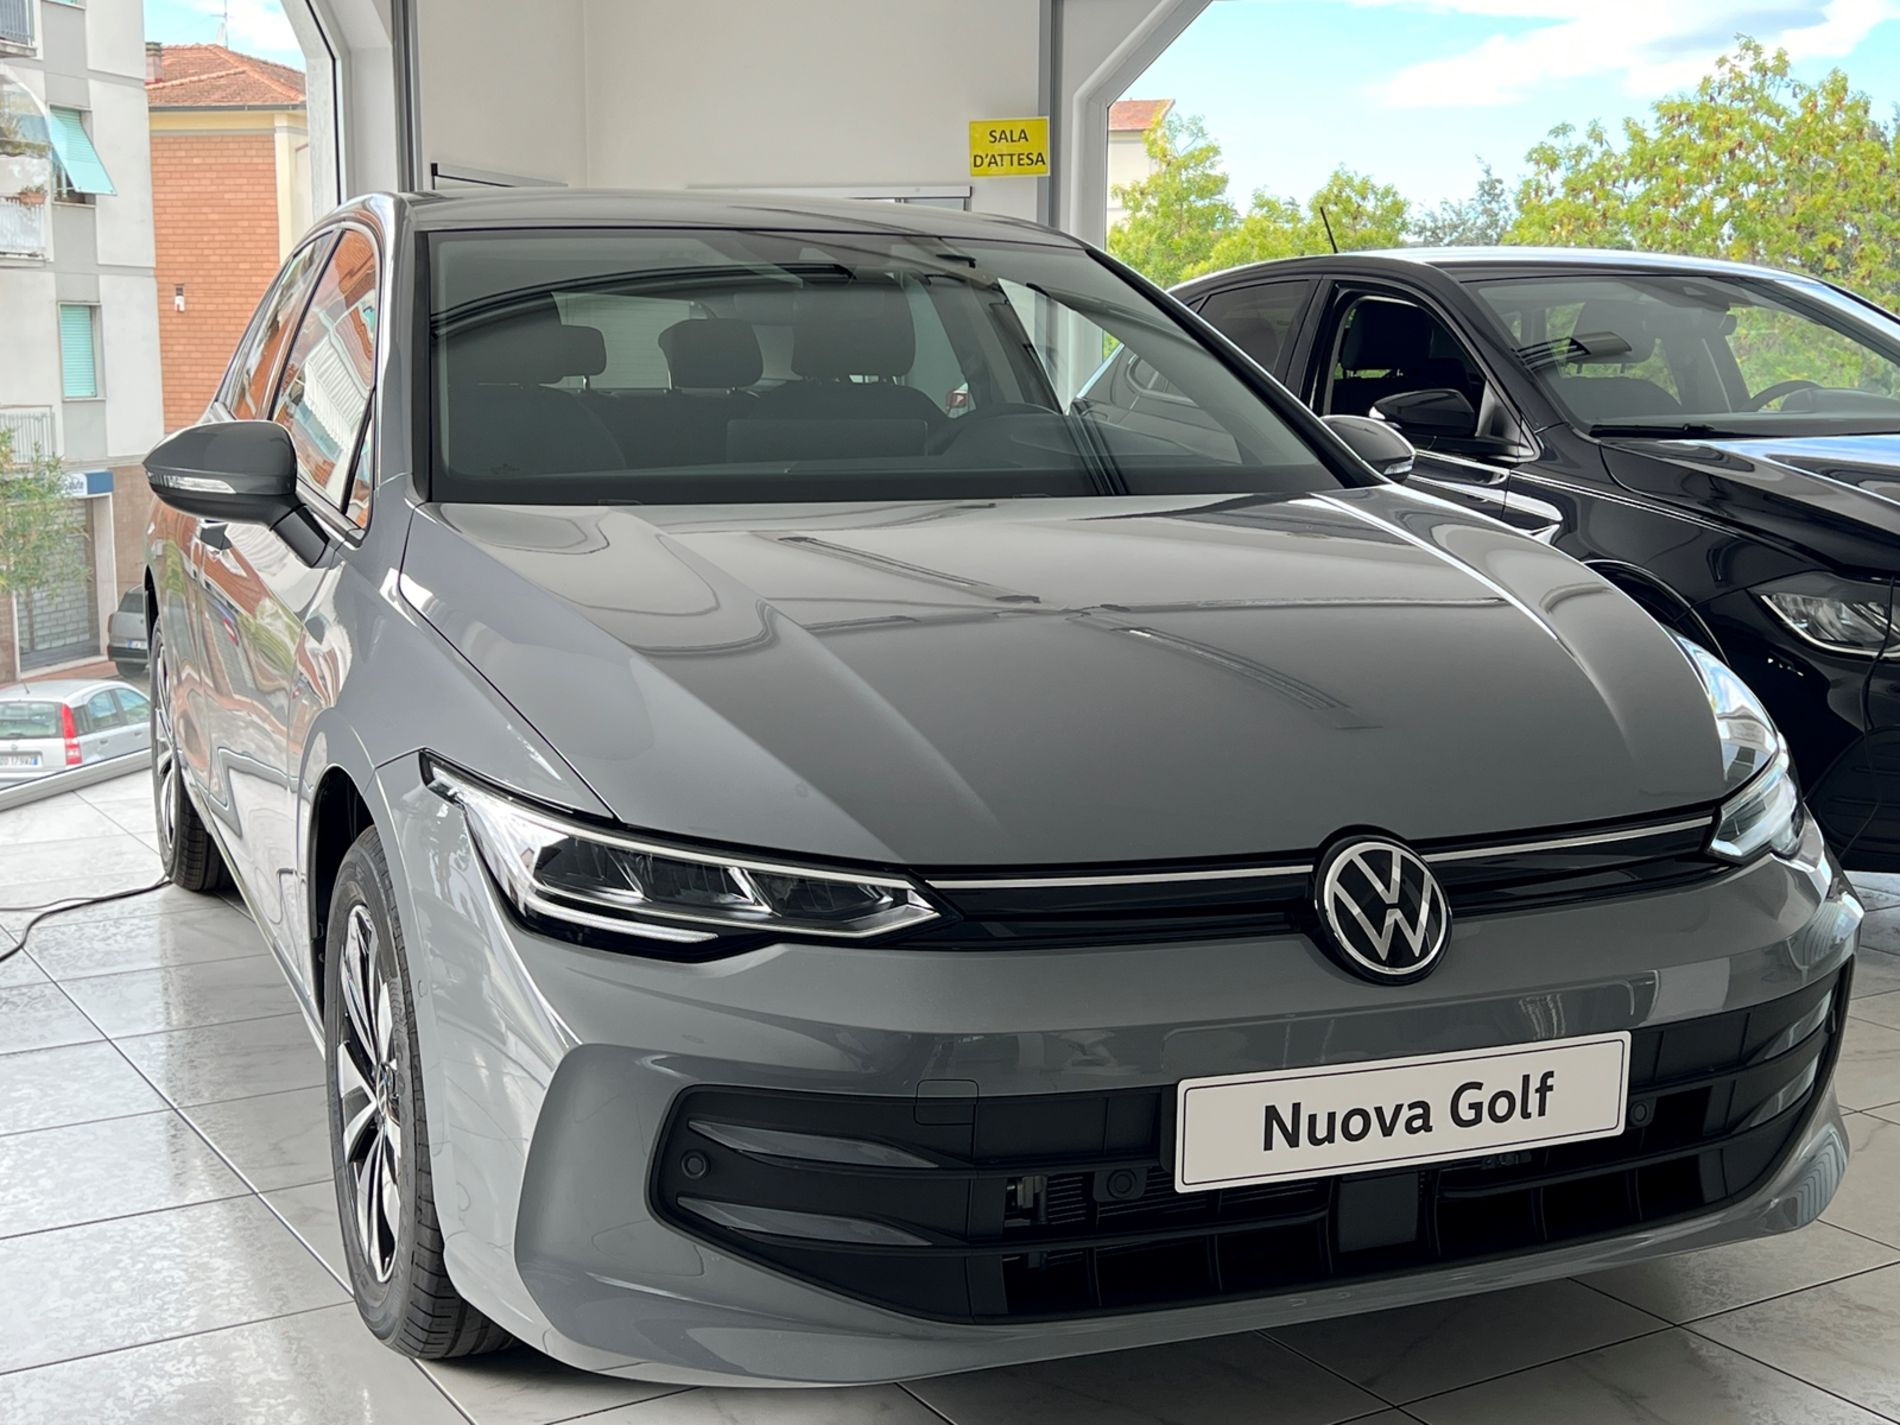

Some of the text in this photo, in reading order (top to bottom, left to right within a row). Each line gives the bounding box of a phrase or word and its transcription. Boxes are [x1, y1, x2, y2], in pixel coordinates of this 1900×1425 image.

[988, 128, 1029, 144] SALA
[973, 151, 1046, 168] D'ATTESA
[1263, 1071, 1555, 1152] Nuova Golf
